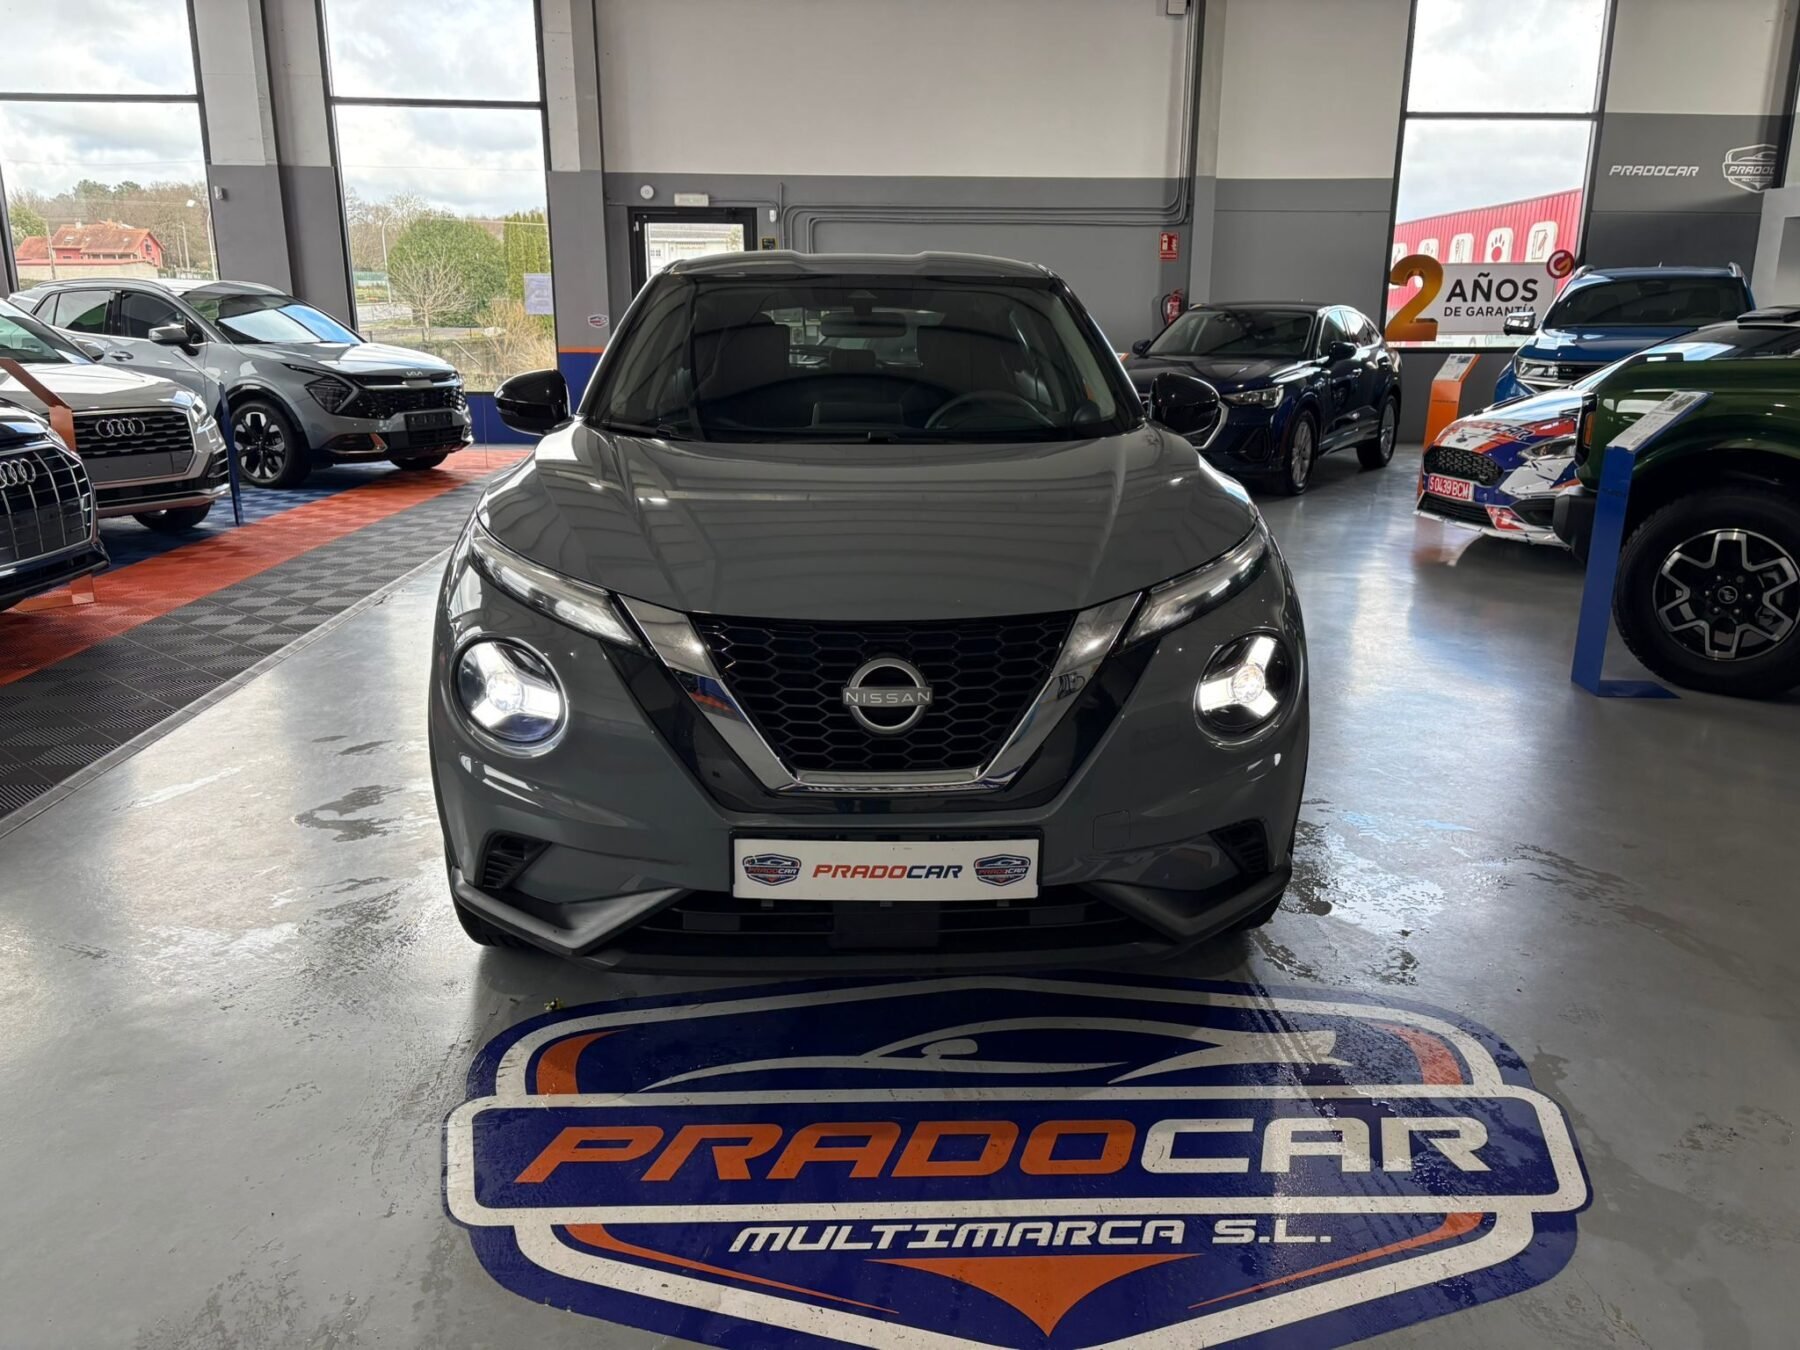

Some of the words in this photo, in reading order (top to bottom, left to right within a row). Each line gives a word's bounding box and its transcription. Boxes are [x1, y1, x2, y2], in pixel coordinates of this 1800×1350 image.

[1608, 165, 1700, 177] PRADOCAR
[1385, 254, 1443, 342] 2
[1446, 272, 1539, 303] AÑOS
[1443, 306, 1462, 317] DE
[1451, 481, 1469, 499] BCM
[845, 691, 930, 704] NISSAN
[812, 865, 963, 879] PRADOCAR
[514, 1117, 1491, 1184] PRADOCAR
[728, 1219, 1185, 1253] MULTIMARCA
[1212, 1219, 1331, 1244] S.L.
